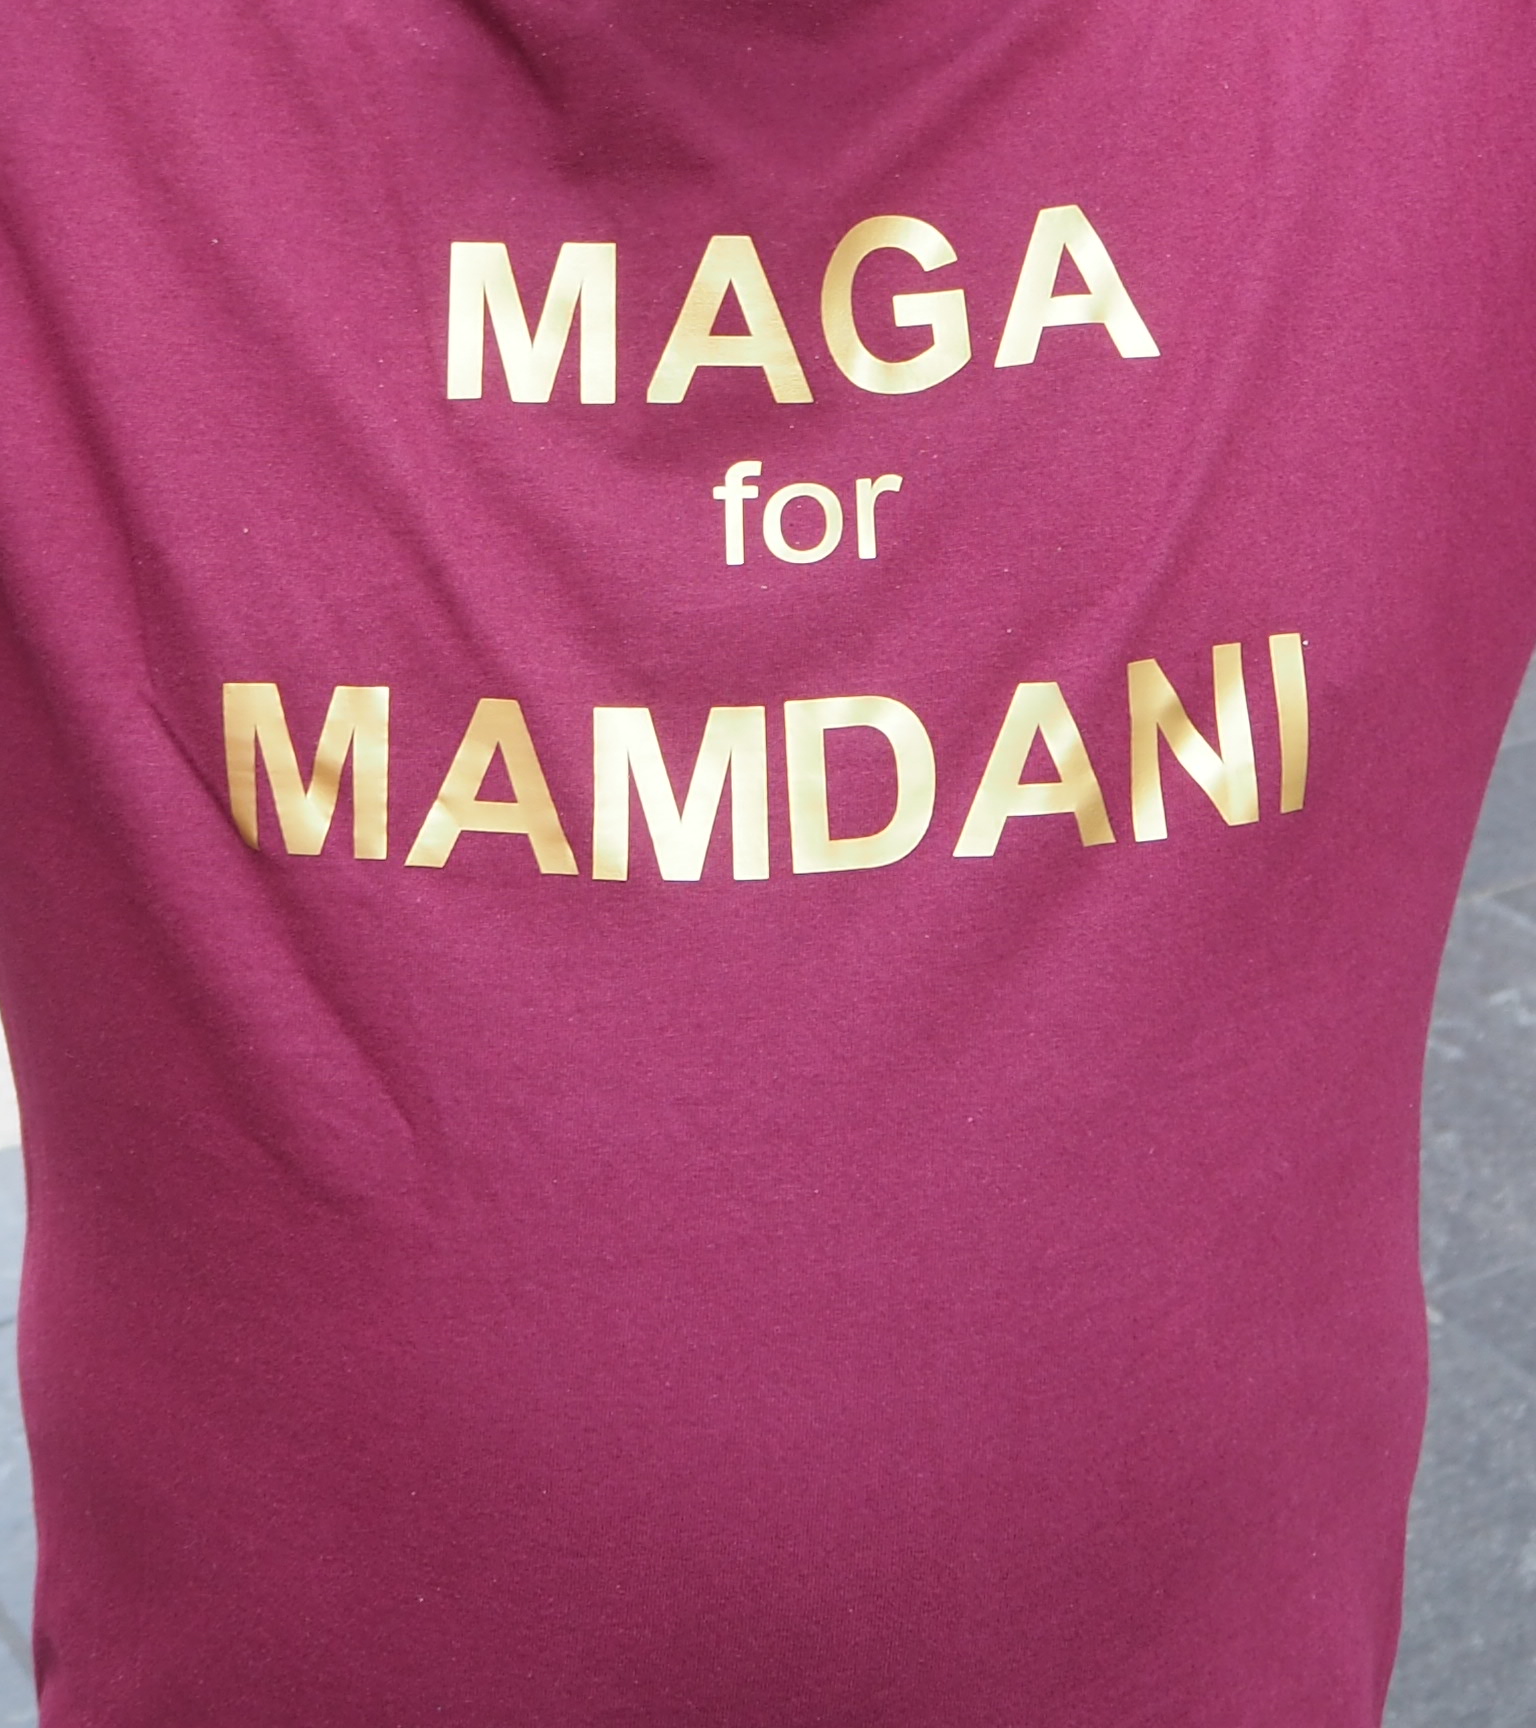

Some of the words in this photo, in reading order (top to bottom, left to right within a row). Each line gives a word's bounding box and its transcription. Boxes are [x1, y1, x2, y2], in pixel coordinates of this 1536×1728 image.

[447, 204, 1160, 404] MAGA
[713, 460, 903, 565] for
[223, 633, 1308, 881] MAMDANI
